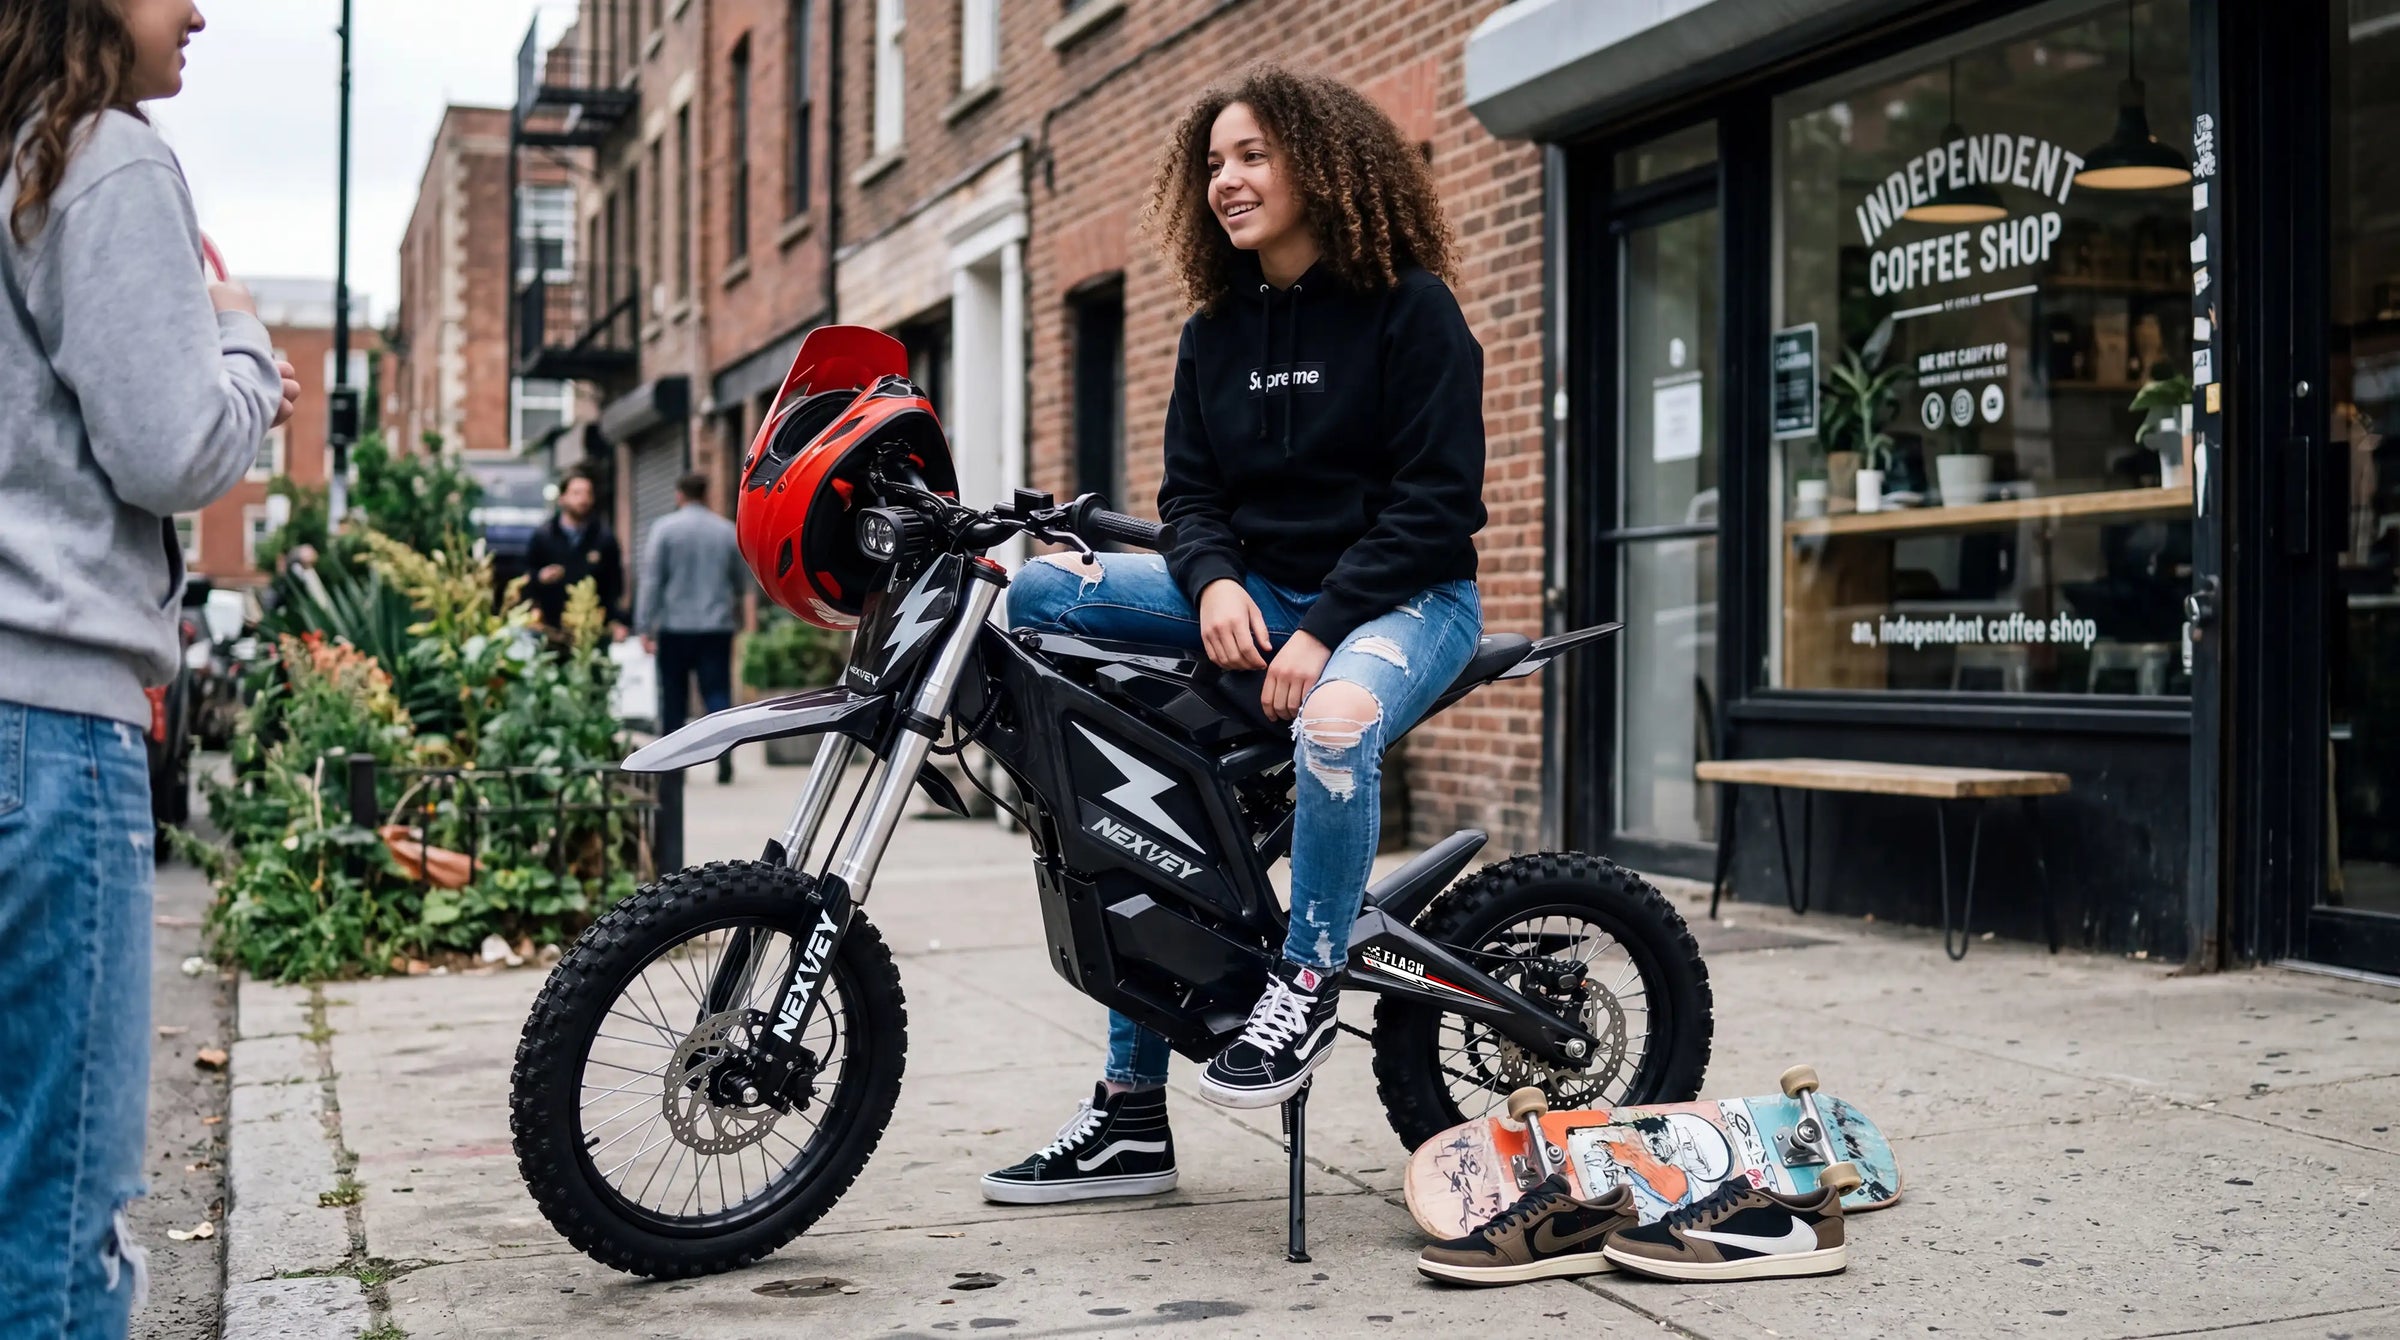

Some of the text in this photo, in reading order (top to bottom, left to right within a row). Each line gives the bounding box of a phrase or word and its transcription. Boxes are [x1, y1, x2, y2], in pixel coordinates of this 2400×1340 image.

[1856, 133, 2085, 247] INDEPENDENT
[1870, 211, 2061, 296] COFFEE SHOP
[1879, 612, 1984, 651] independent
[1988, 611, 2046, 643] coffee
[2049, 611, 2097, 650] shop
[849, 665, 880, 686] NEXVEY
[1090, 816, 1203, 879] NEXVEY
[772, 908, 839, 1043] NEXVEY
